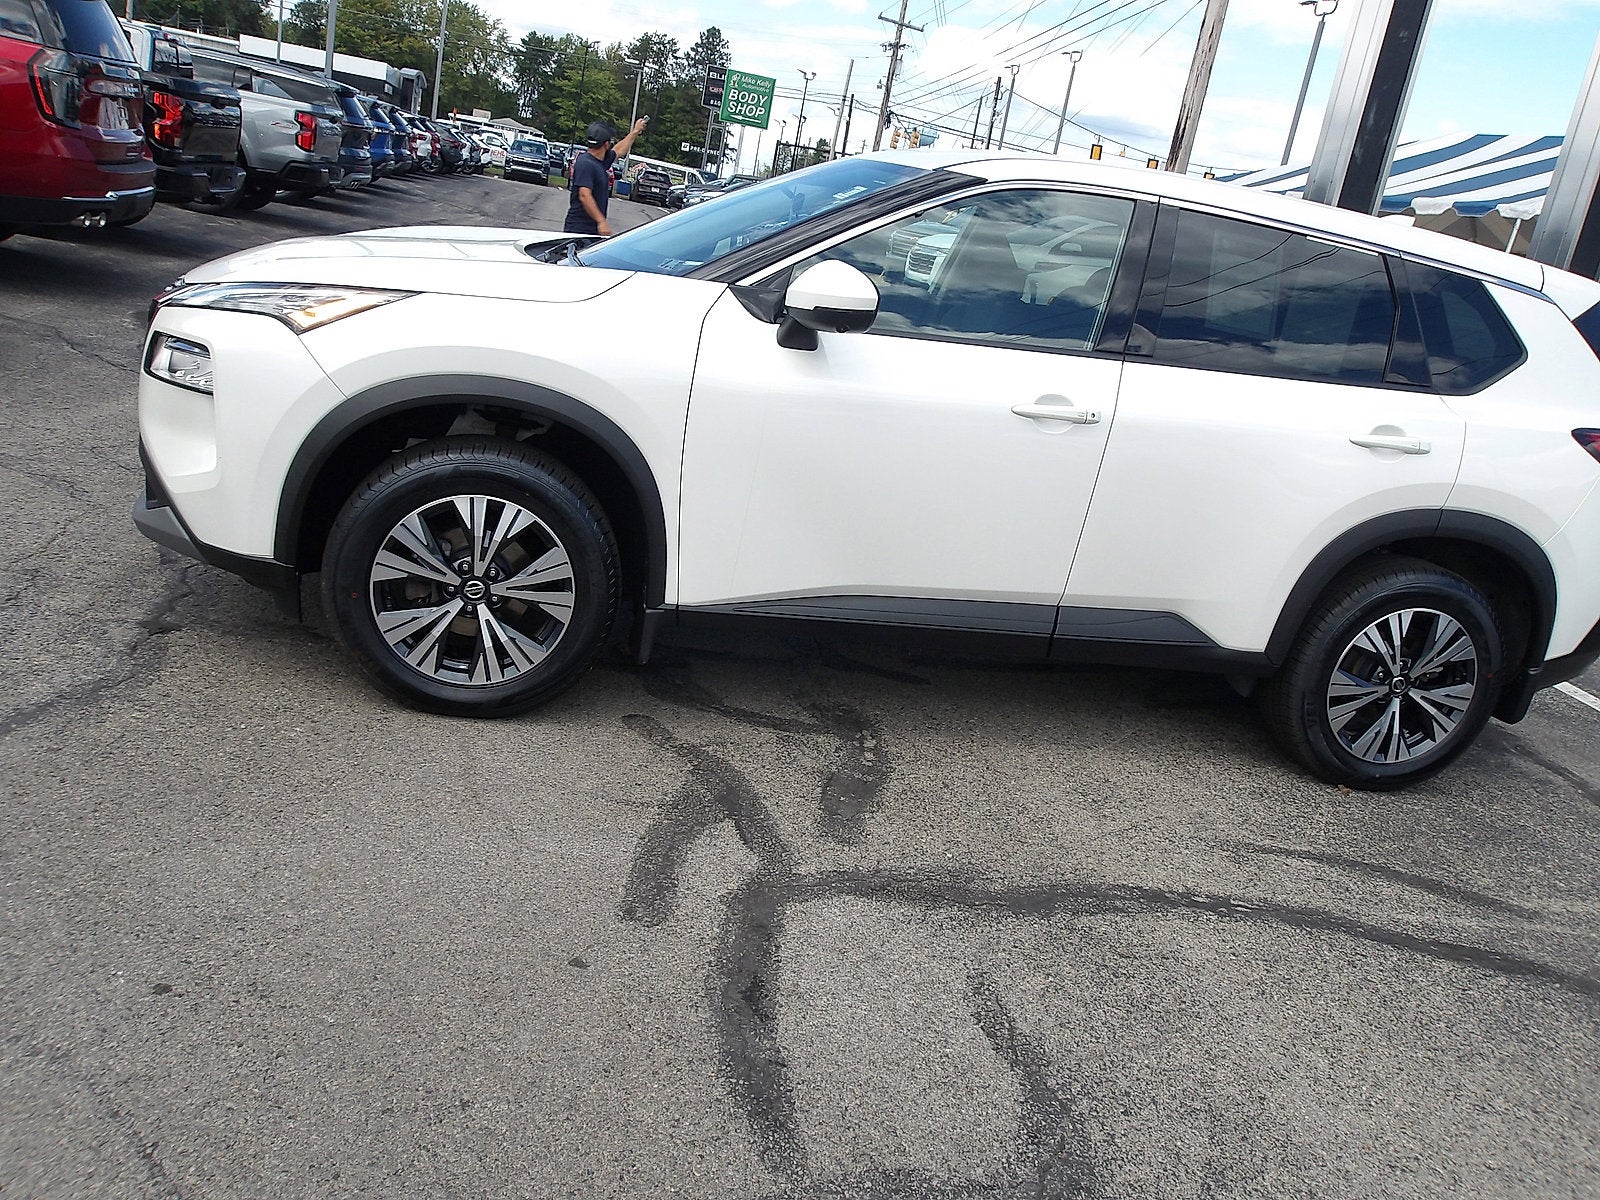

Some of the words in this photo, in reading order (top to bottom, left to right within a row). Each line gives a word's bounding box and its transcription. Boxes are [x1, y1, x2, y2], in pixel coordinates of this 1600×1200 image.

[741, 75, 756, 84] Mike
[756, 79, 772, 89] Kelly
[741, 83, 770, 92] Automotive
[728, 88, 768, 106] BODY
[727, 101, 766, 117] SHOP
